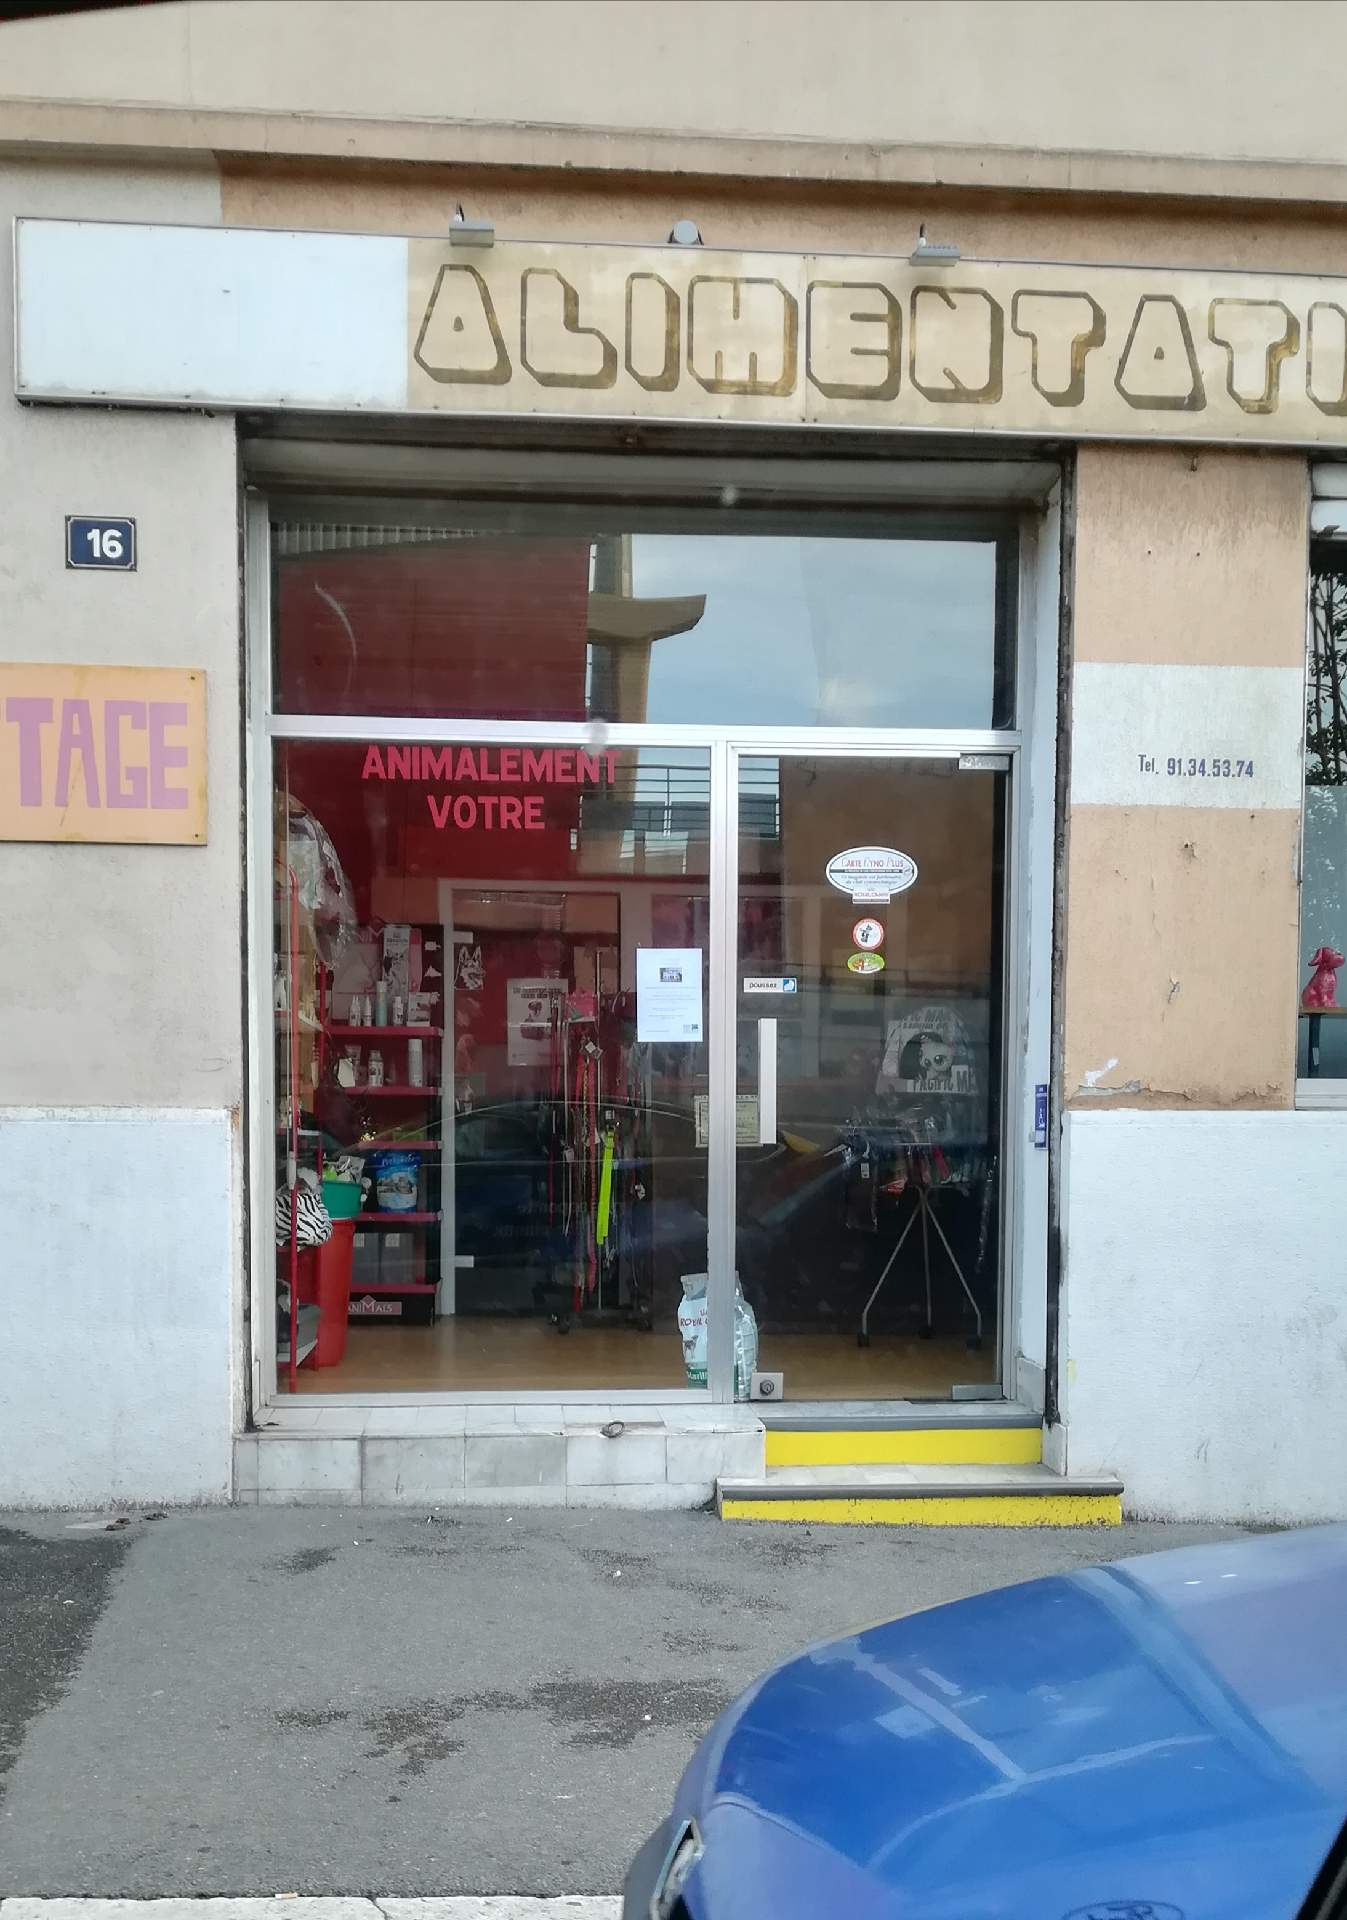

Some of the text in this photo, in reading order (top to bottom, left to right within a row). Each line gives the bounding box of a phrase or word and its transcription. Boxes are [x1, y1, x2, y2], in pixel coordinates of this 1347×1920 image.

[414, 262, 1347, 417] ALIMENTATI
[87, 528, 123, 558] 16
[0, 697, 188, 809] TAGE
[361, 745, 622, 784] ANIMALEMENT
[1138, 754, 1254, 777] Tel. 91.34.53.74
[427, 795, 545, 829] VOTRE
